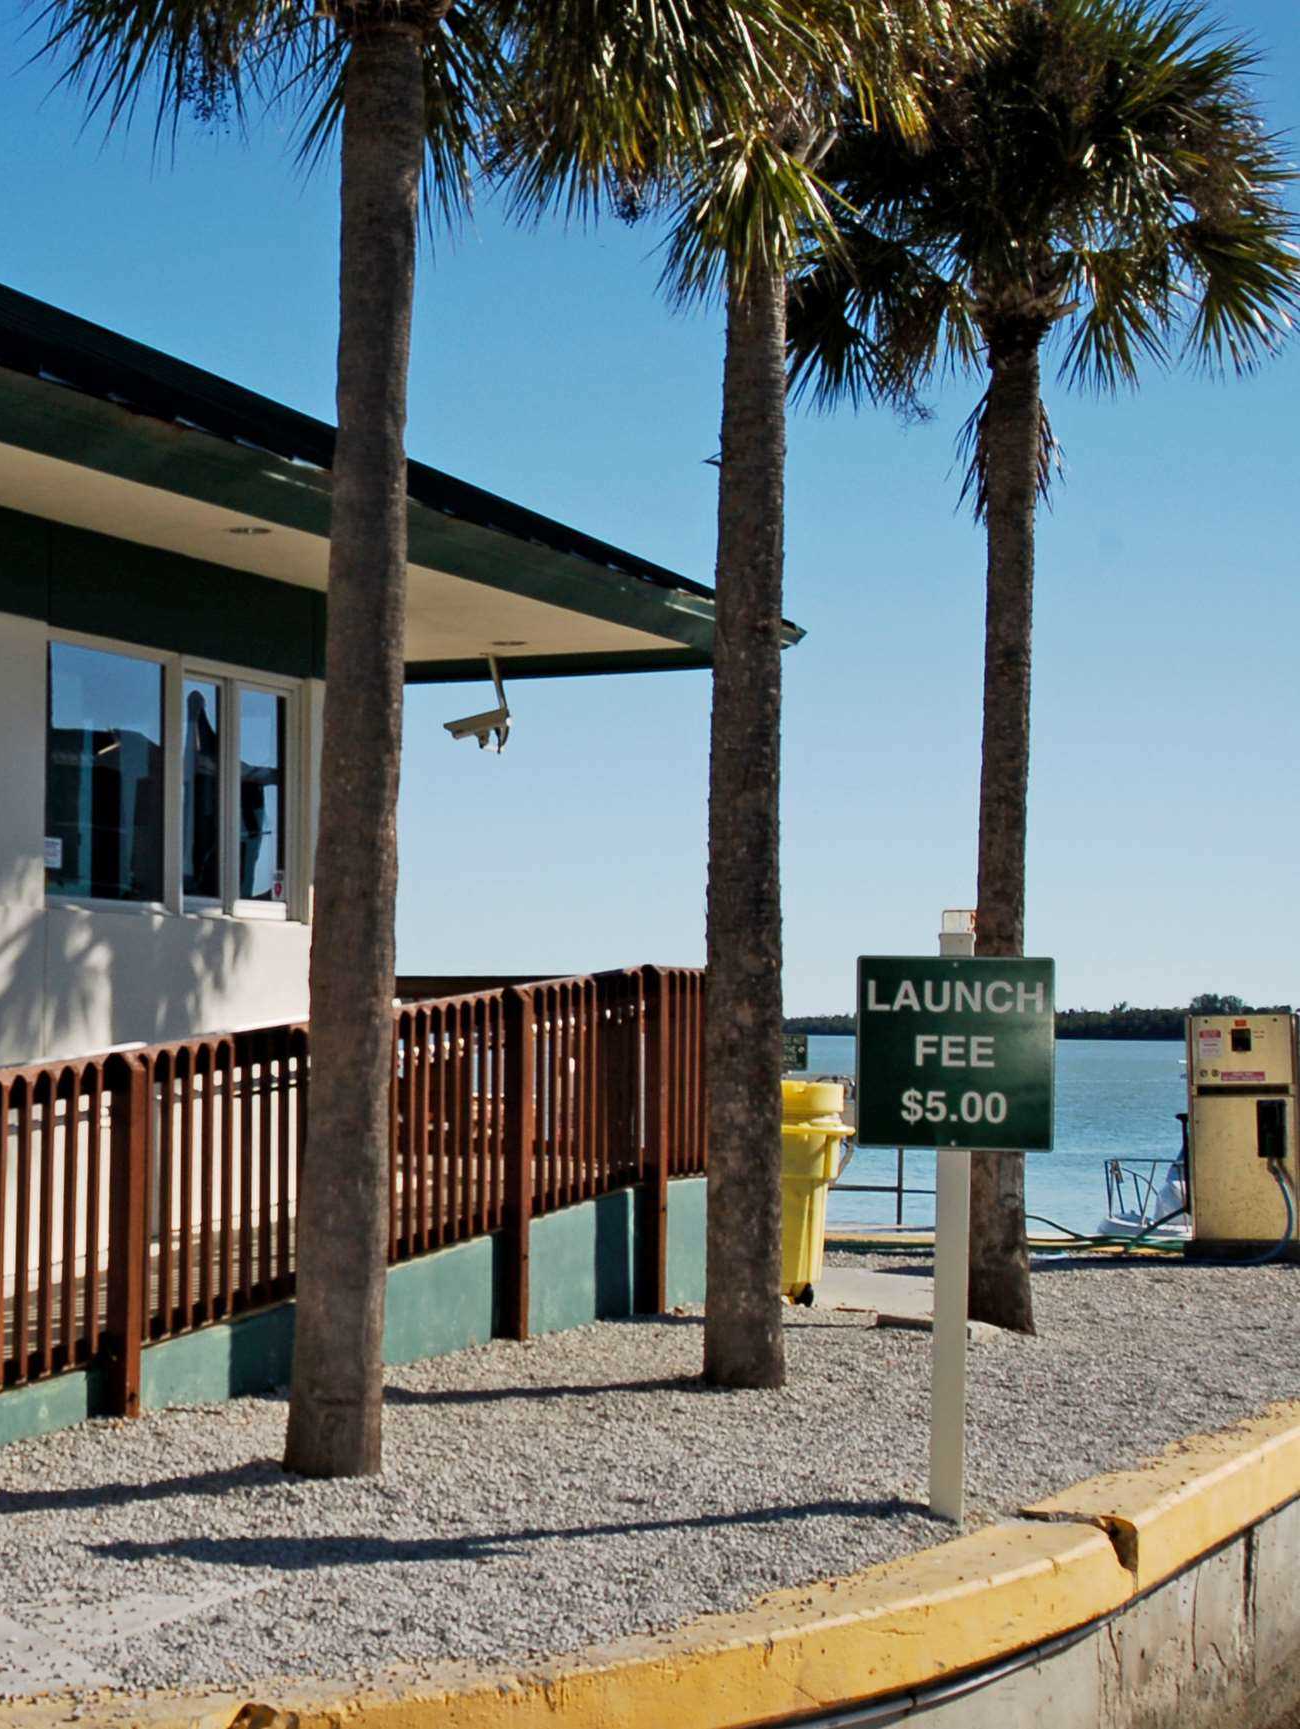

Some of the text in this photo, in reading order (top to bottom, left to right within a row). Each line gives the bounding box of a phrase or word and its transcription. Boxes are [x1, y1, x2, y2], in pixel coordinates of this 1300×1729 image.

[867, 980, 1044, 1013] LAUNCH
[914, 1034, 996, 1067] FEE
[900, 1088, 1007, 1125] $5.00
